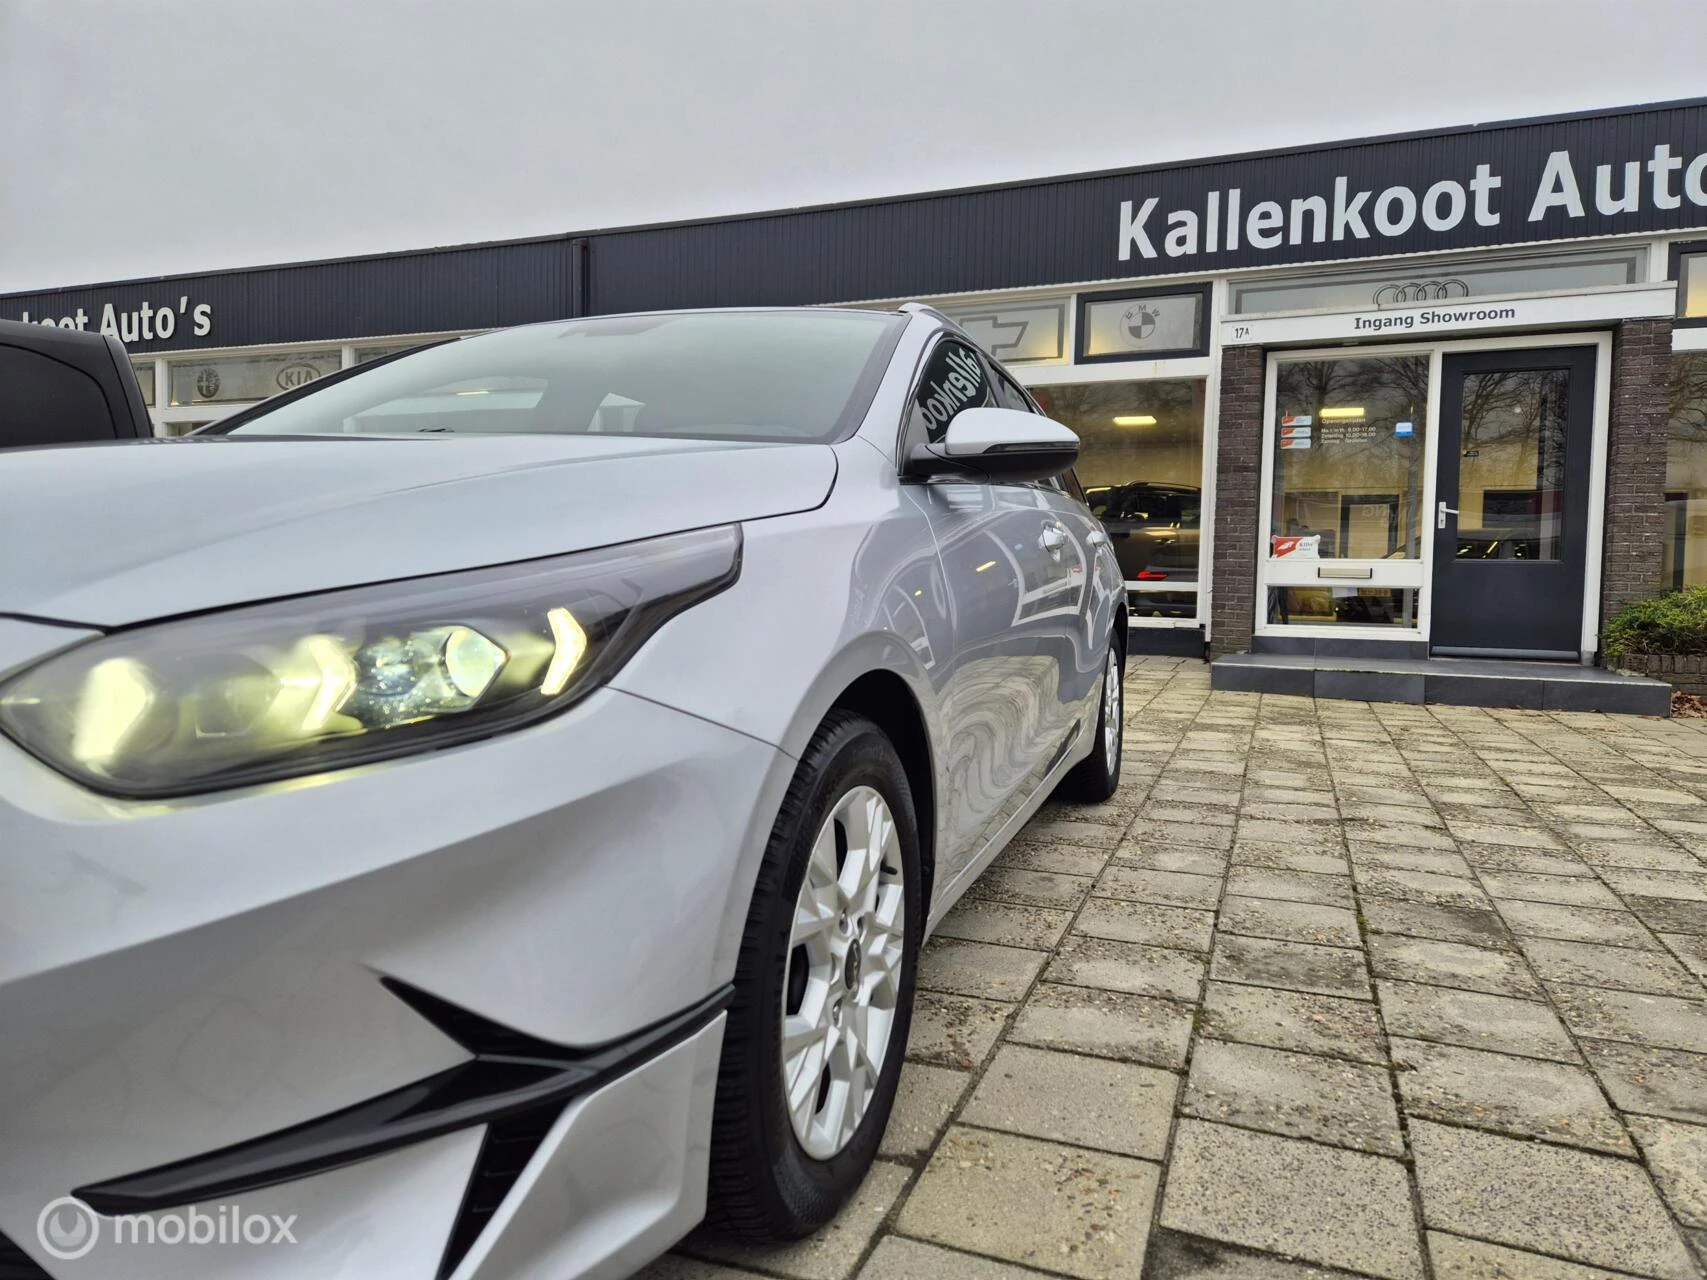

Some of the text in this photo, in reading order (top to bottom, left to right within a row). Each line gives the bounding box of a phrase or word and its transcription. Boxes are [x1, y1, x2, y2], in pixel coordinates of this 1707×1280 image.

[1118, 164, 1501, 261] Kallenkoot
[100, 296, 211, 343] Auto's
[1354, 308, 1516, 331] Ingang Showroom
[1235, 328, 1250, 339] 17A
[284, 370, 313, 387] KIA
